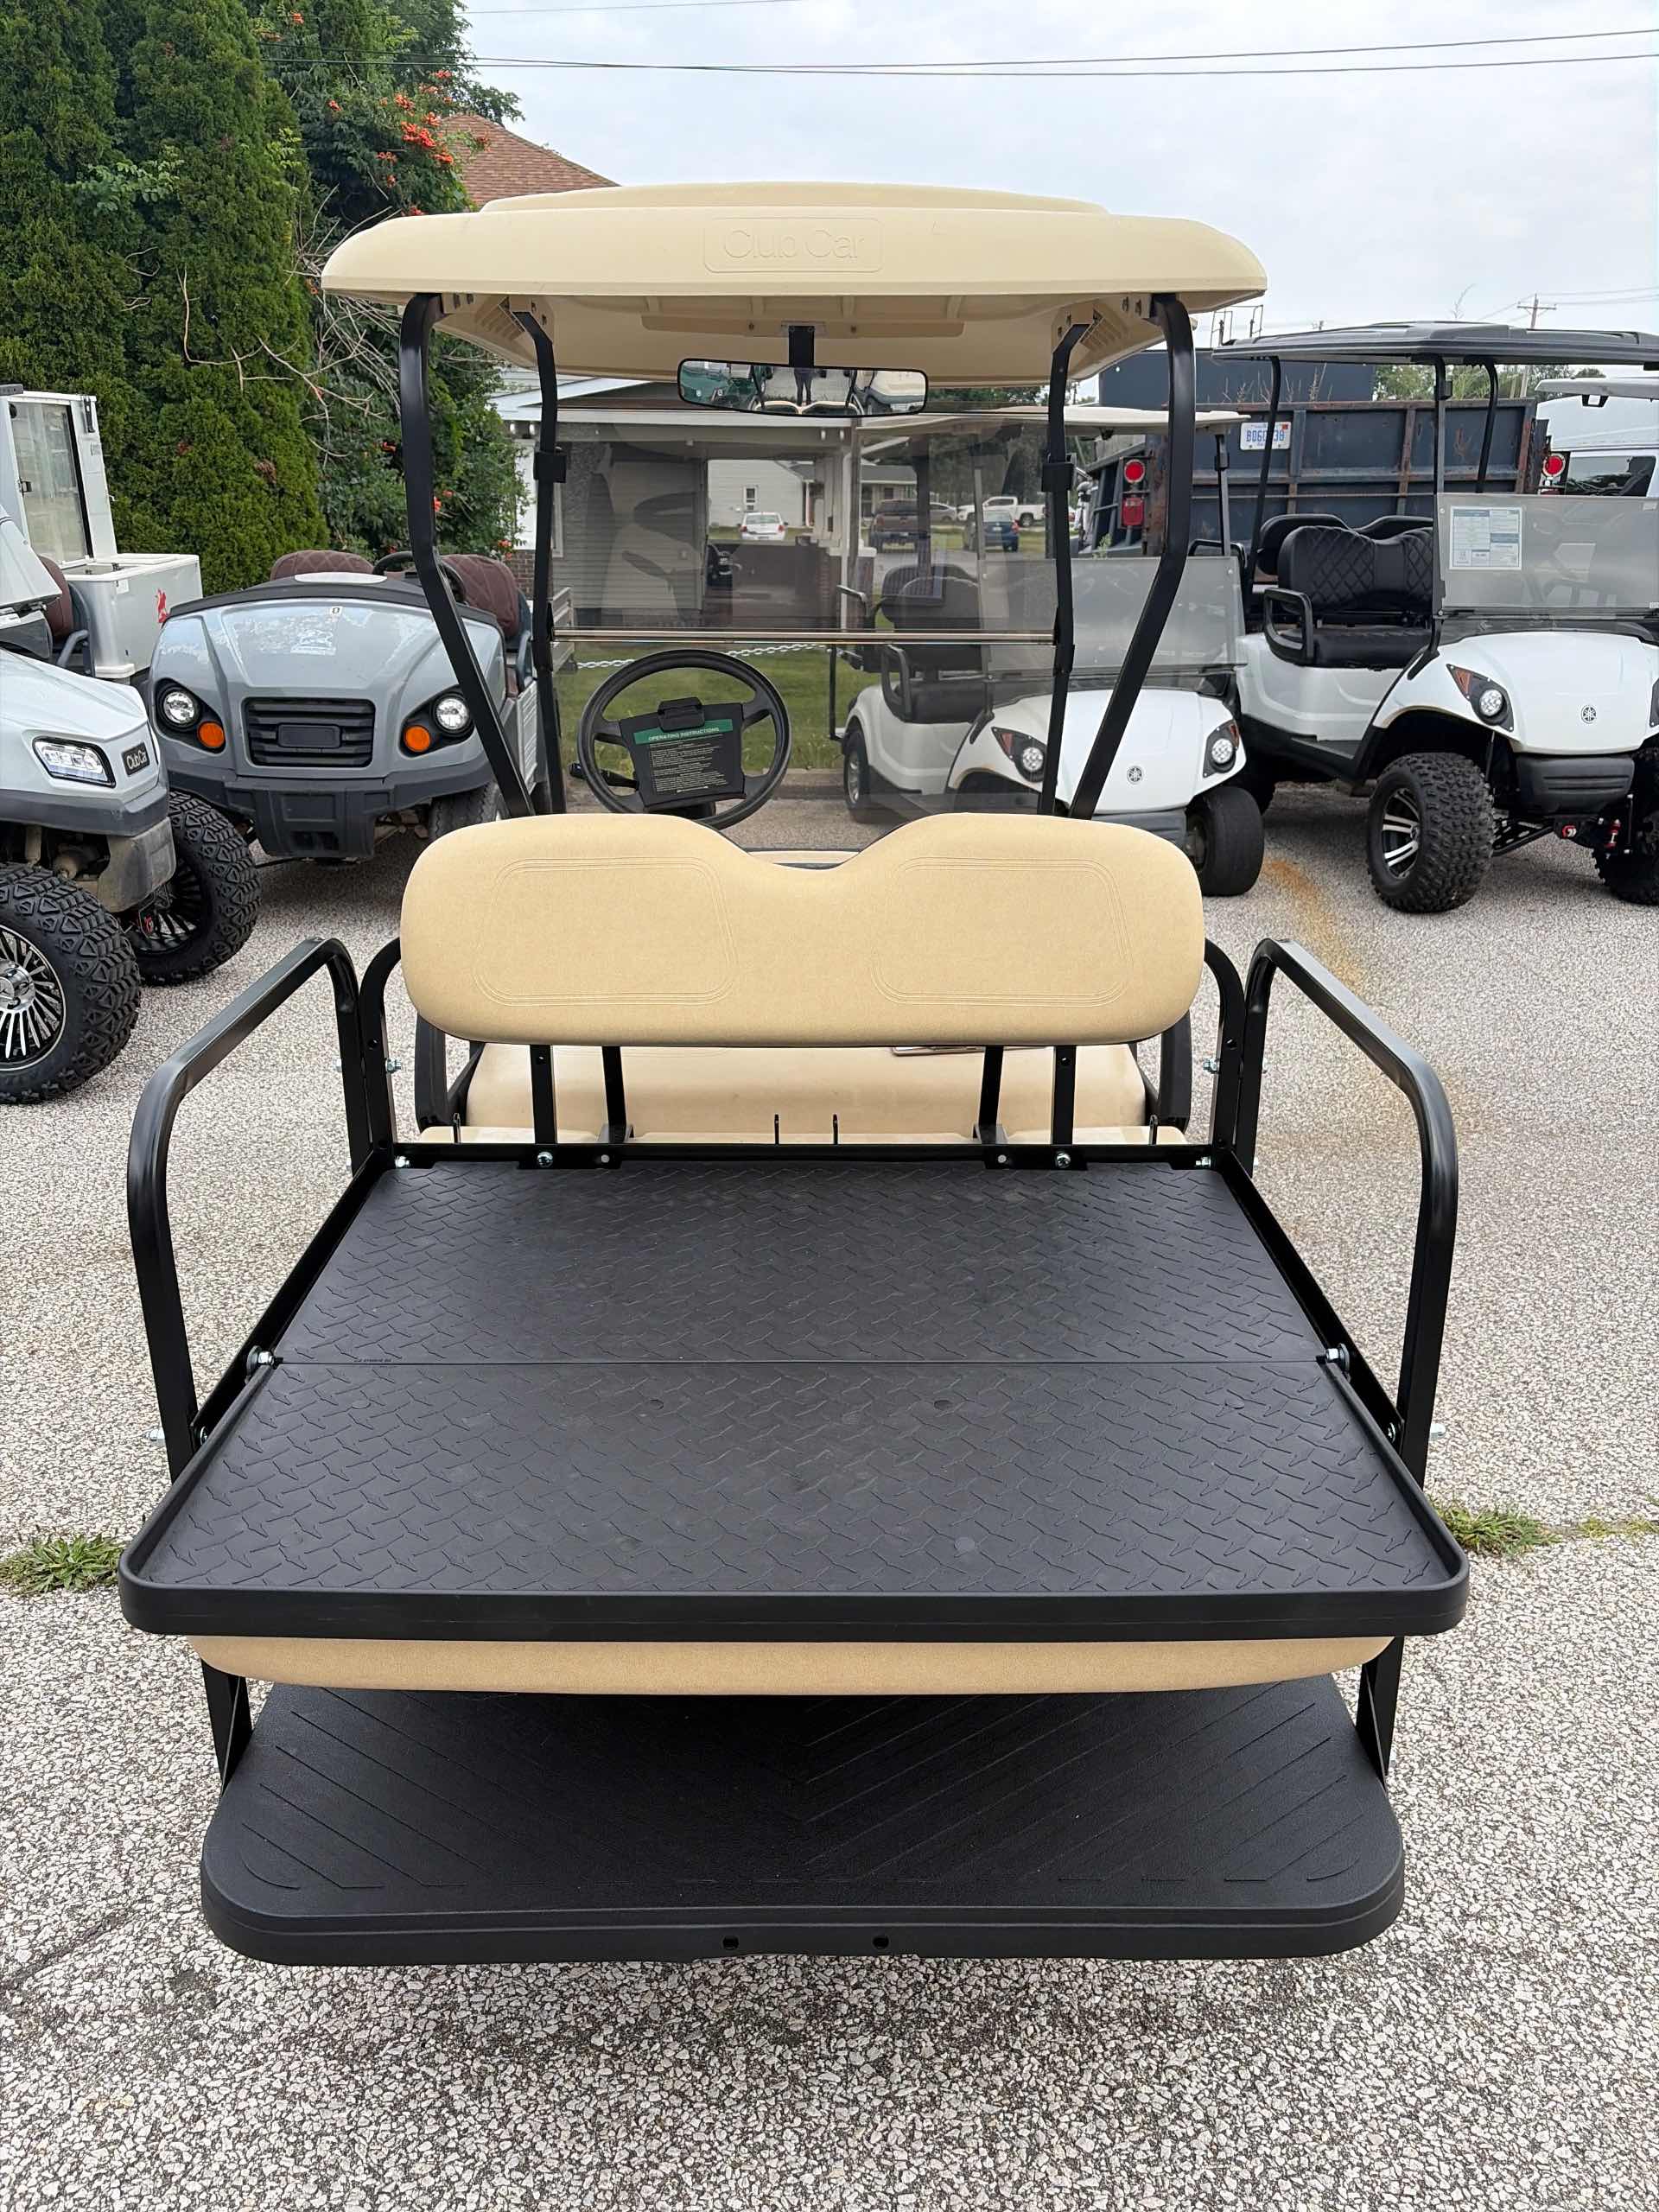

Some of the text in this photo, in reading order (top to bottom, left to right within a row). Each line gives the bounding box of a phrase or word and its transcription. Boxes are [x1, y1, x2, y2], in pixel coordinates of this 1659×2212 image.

[724, 229, 865, 258] Club Car
[138, 749, 147, 764] Ca
